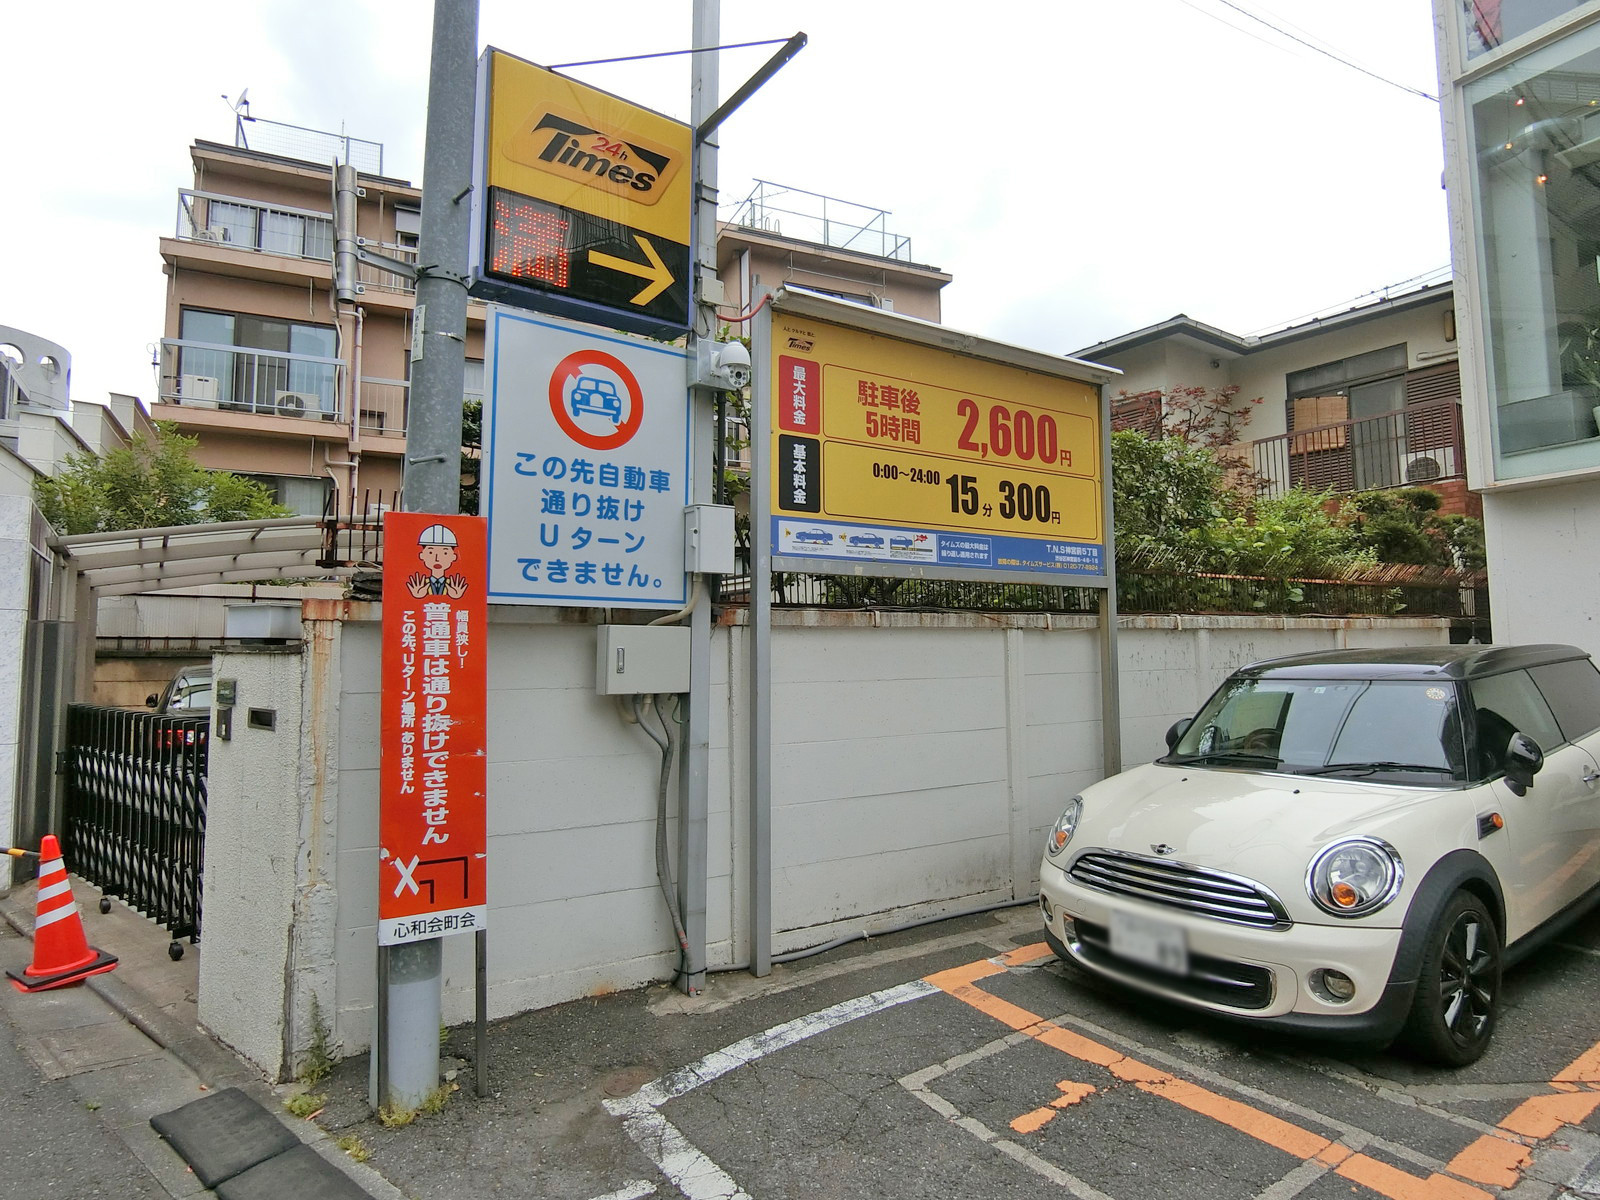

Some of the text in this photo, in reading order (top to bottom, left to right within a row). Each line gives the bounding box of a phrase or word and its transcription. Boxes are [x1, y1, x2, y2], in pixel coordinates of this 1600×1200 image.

[531, 112, 671, 191] Times
[592, 136, 628, 161] 24h
[788, 337, 814, 351] Times
[793, 365, 806, 425] 最大料金
[857, 380, 921, 416] 駐車後
[865, 411, 921, 444] 5時間
[957, 398, 1072, 467] 2,600円
[514, 452, 671, 493] この先自動車
[793, 444, 807, 504] 基本料金
[541, 489, 645, 522] 通り抜け
[946, 474, 993, 518] 15分
[999, 480, 1061, 524] 300円
[540, 523, 645, 553] Uターン
[517, 558, 662, 588] できません。
[421, 602, 451, 845] 普通車は通り抜けできません
[400, 732, 415, 794] ありません
[394, 912, 476, 939] 心和会町会
